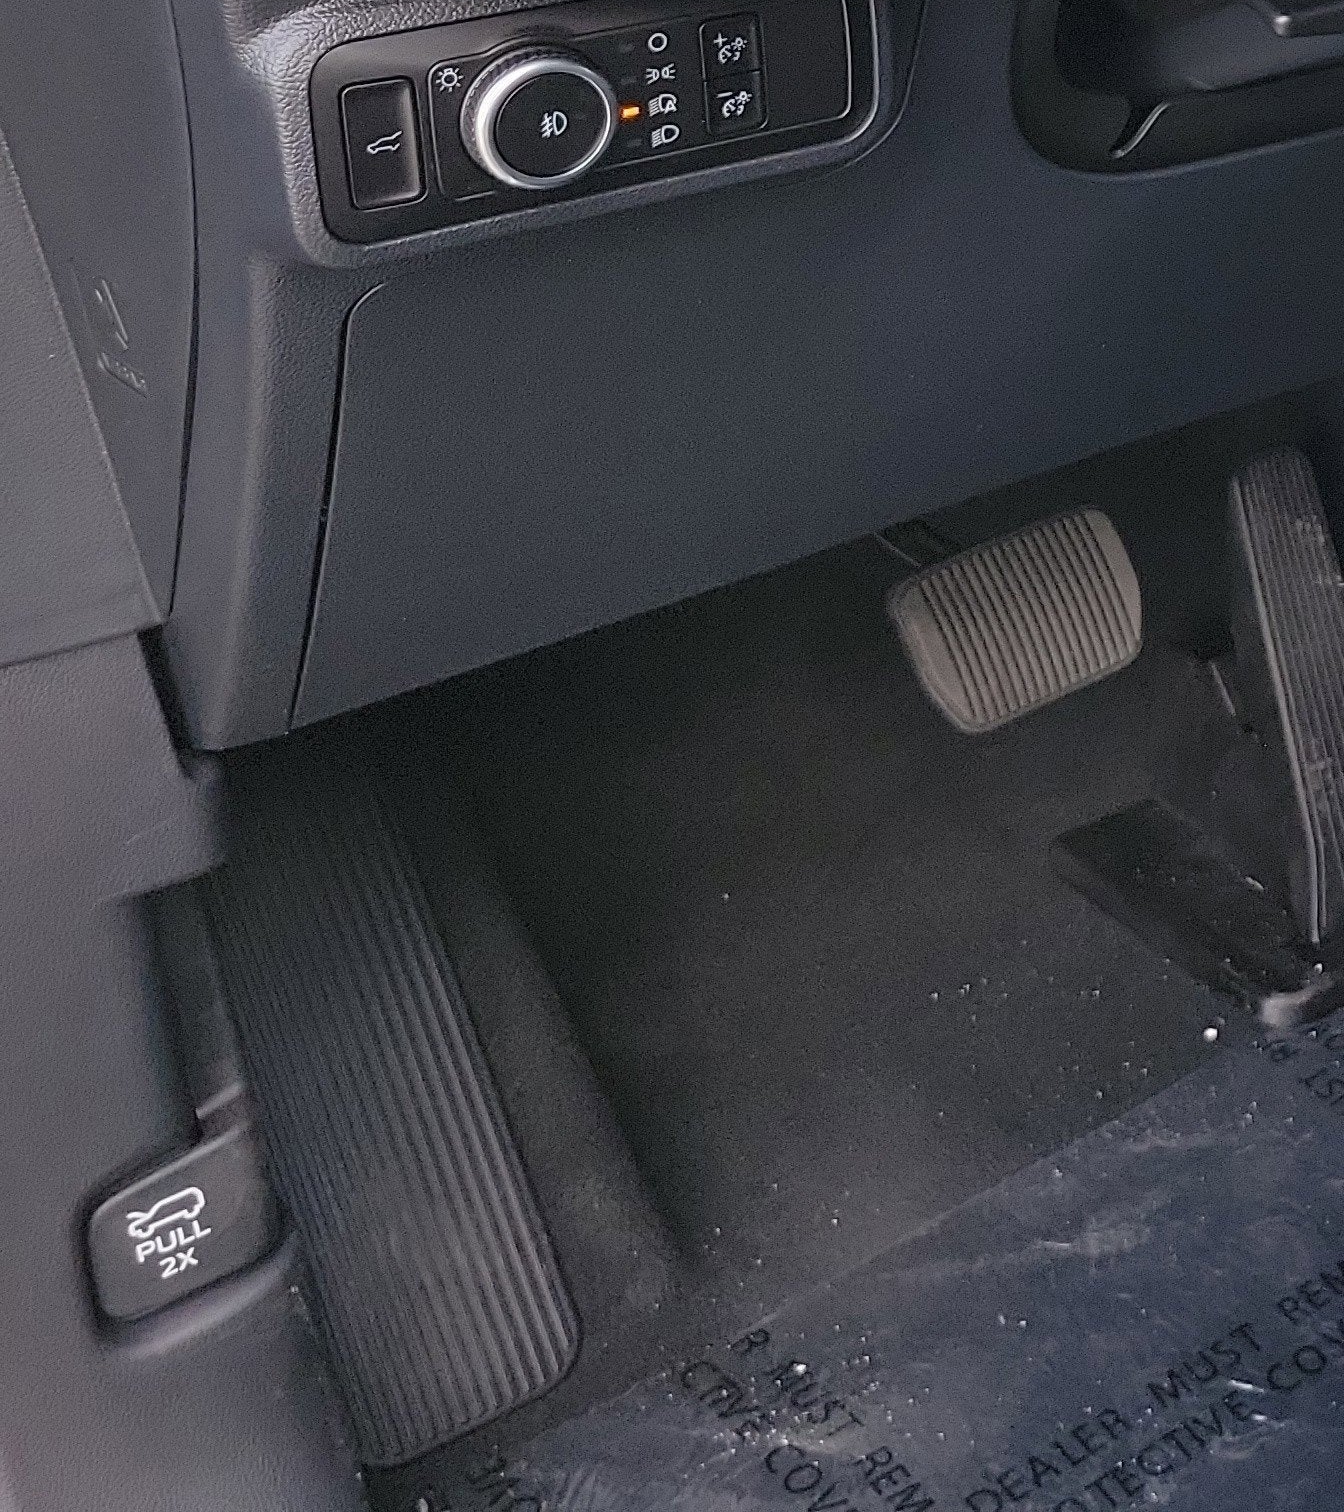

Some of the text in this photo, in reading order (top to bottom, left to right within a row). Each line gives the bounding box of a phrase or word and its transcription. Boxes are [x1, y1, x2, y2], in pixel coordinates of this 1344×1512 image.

[136, 1220, 212, 1263] PULL
[159, 1247, 199, 1279] 2X
[1147, 1322, 1261, 1408] MUST
